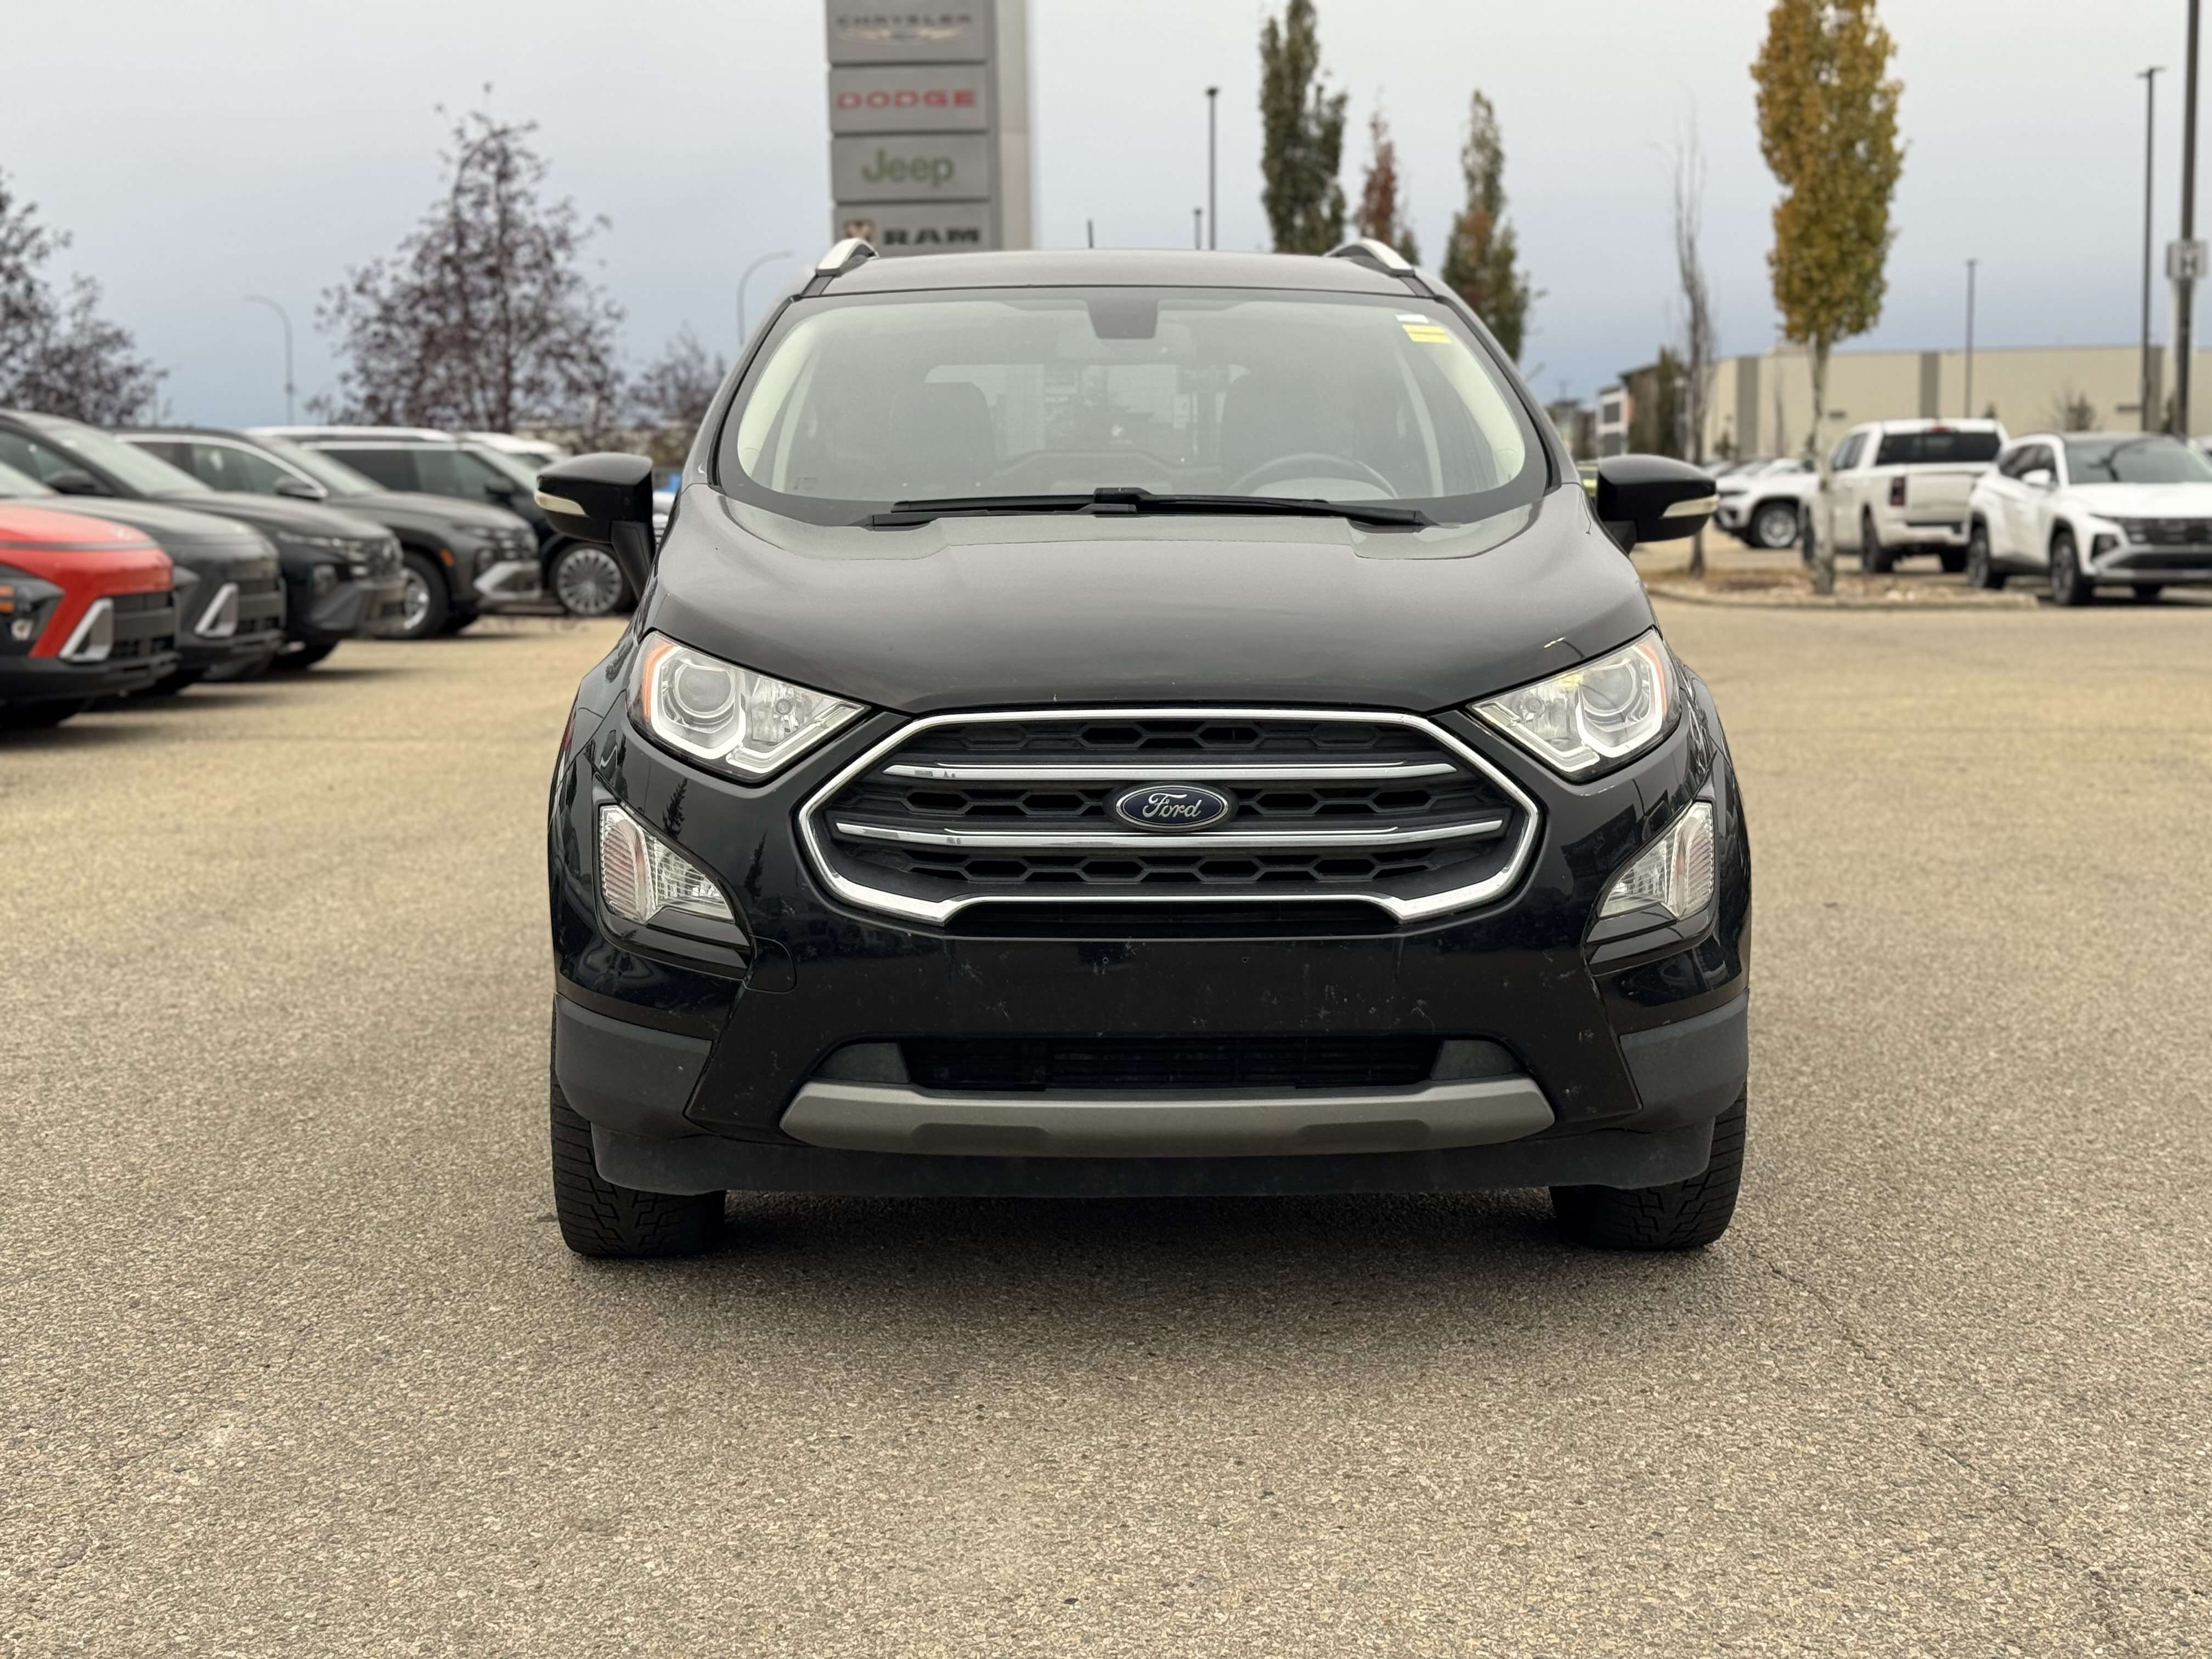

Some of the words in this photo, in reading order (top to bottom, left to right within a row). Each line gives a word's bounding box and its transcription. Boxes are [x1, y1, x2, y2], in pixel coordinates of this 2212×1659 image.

[837, 89, 976, 109] DODGE
[862, 148, 955, 187] Jeep
[884, 228, 980, 245] RAM
[1142, 793, 1202, 817] Ford
